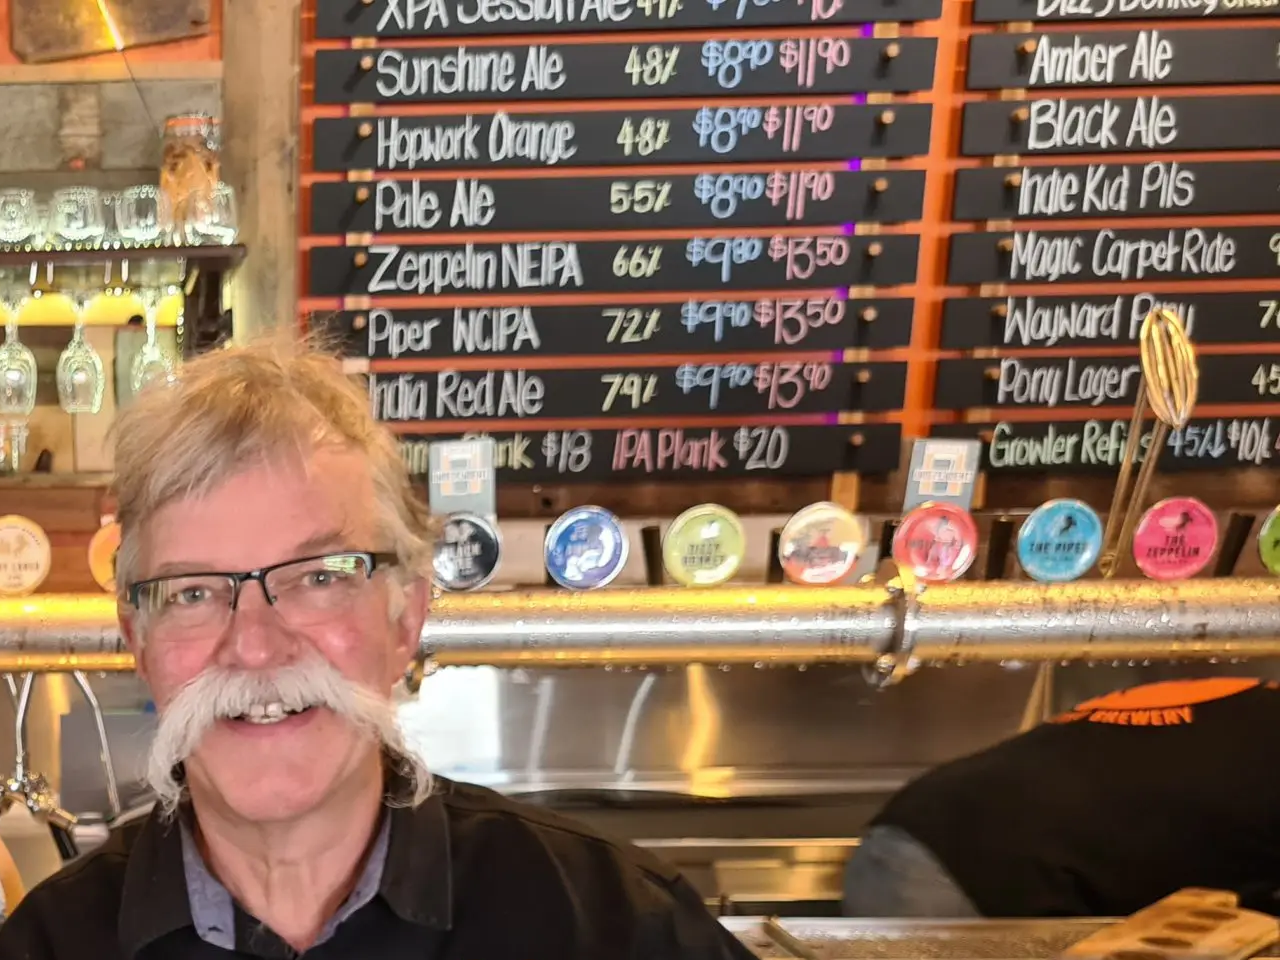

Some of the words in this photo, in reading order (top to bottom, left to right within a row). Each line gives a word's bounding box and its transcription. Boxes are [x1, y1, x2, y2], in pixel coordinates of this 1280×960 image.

[376, 46, 516, 96] Sunshine
[521, 44, 566, 92] Ale
[1029, 35, 1128, 85] Amber
[1129, 30, 1173, 81] Ale
[377, 113, 480, 169] Hopwork
[489, 109, 578, 164] Orange
[1028, 98, 1120, 150] Black
[1126, 95, 1178, 148] Ale
[375, 178, 442, 230] Pale
[449, 178, 495, 228] Ale
[1019, 167, 1078, 215] Indie
[1082, 164, 1129, 213] Kid
[1140, 162, 1195, 208] Pils
[368, 242, 497, 295] Zeppelin
[501, 240, 584, 288] NEIPA
[1010, 229, 1084, 281] Magic
[1092, 228, 1180, 280] Carpet
[1181, 228, 1237, 274] Ride
[368, 308, 442, 359] Piper
[1003, 294, 1123, 346] Wayward
[436, 367, 496, 418] Red
[498, 367, 545, 417] Ale
[997, 358, 1063, 407] Pony
[1064, 357, 1141, 406] Lager
[461, 432, 535, 470] ank
[541, 429, 593, 474] $18
[612, 428, 654, 473] IPA
[657, 427, 728, 471] Plank
[733, 425, 790, 470] $20
[989, 420, 1080, 468] Growler
[1081, 418, 1156, 466] Refis
